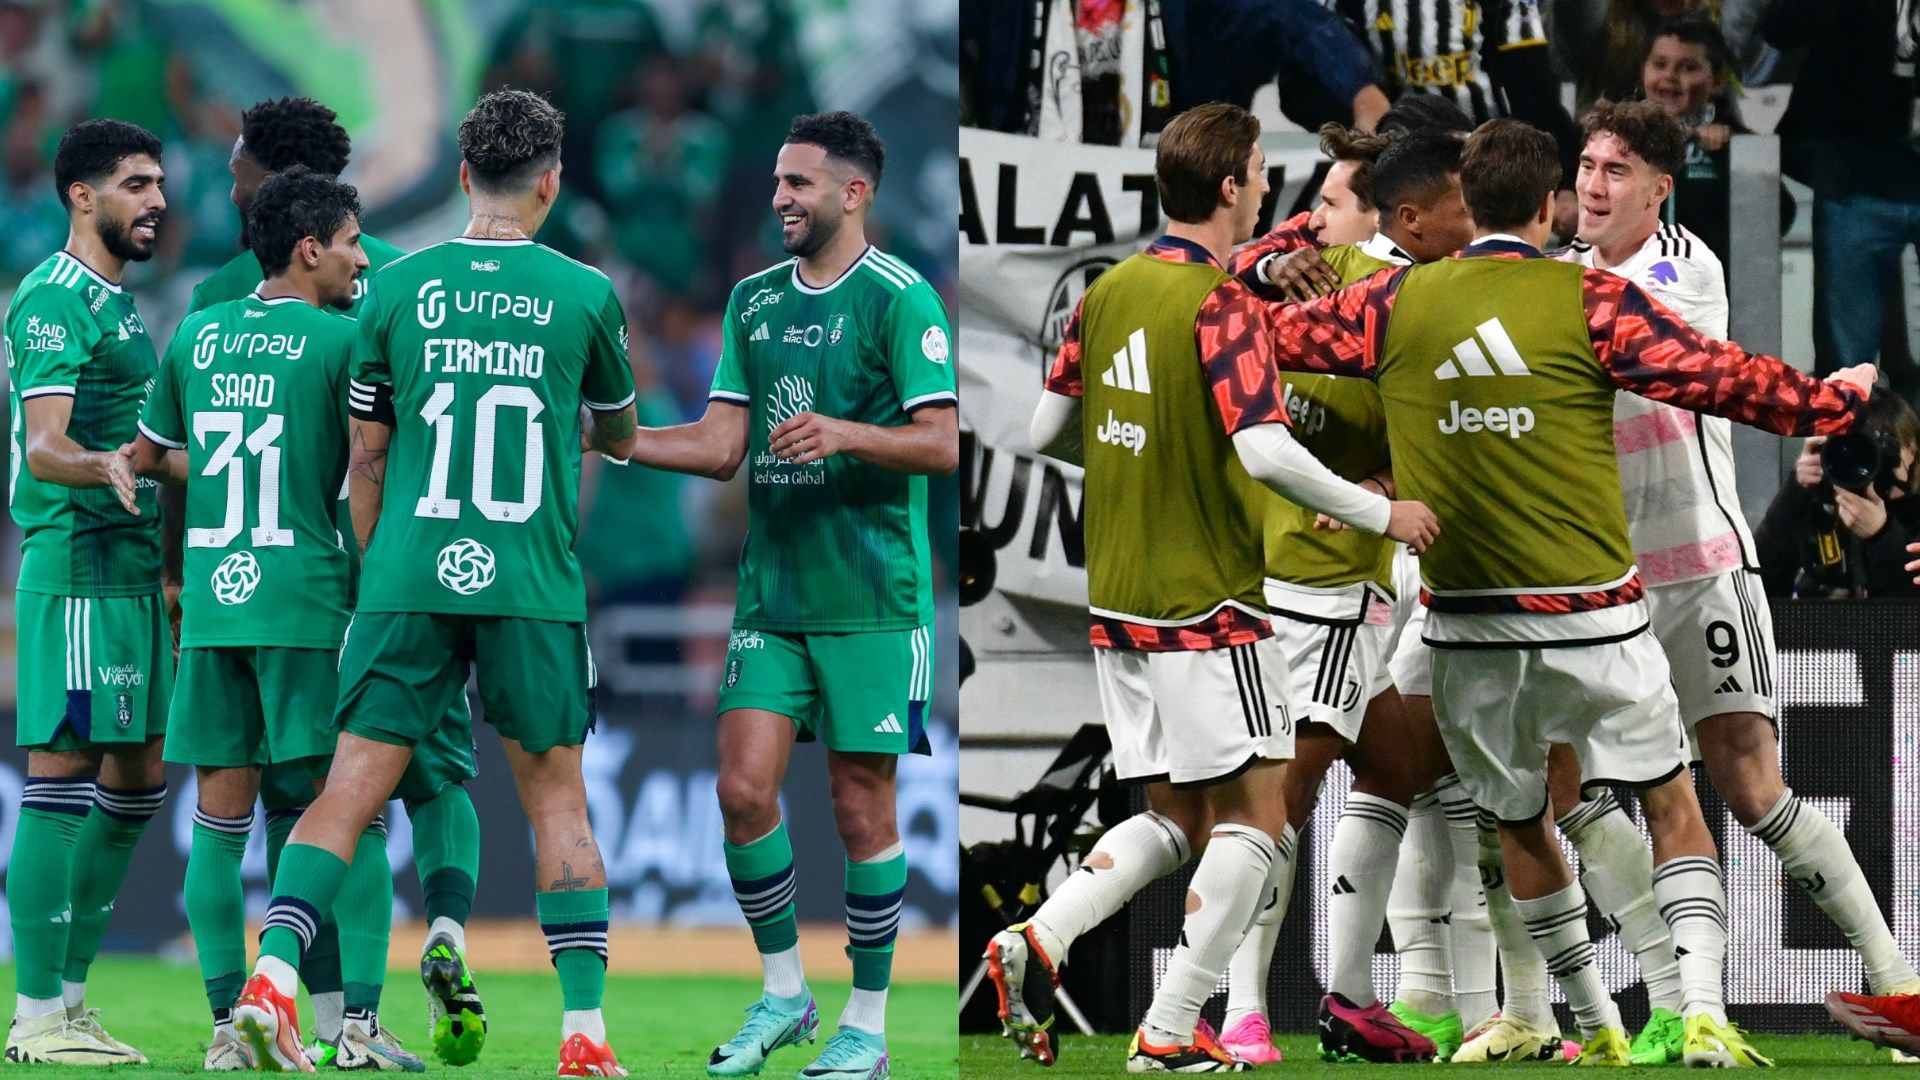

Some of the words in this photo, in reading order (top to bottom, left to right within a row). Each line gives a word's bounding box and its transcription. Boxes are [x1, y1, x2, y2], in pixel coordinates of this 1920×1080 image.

[455, 290, 553, 325] urpay
[223, 333, 307, 361] urpay
[424, 338, 544, 379] FIRMINO
[211, 373, 275, 408] SAAD
[1097, 409, 1146, 456] Jeep
[1438, 400, 1535, 439] Jeep
[414, 382, 545, 523] 10
[187, 412, 295, 548] 31
[1705, 620, 1740, 668] 9
